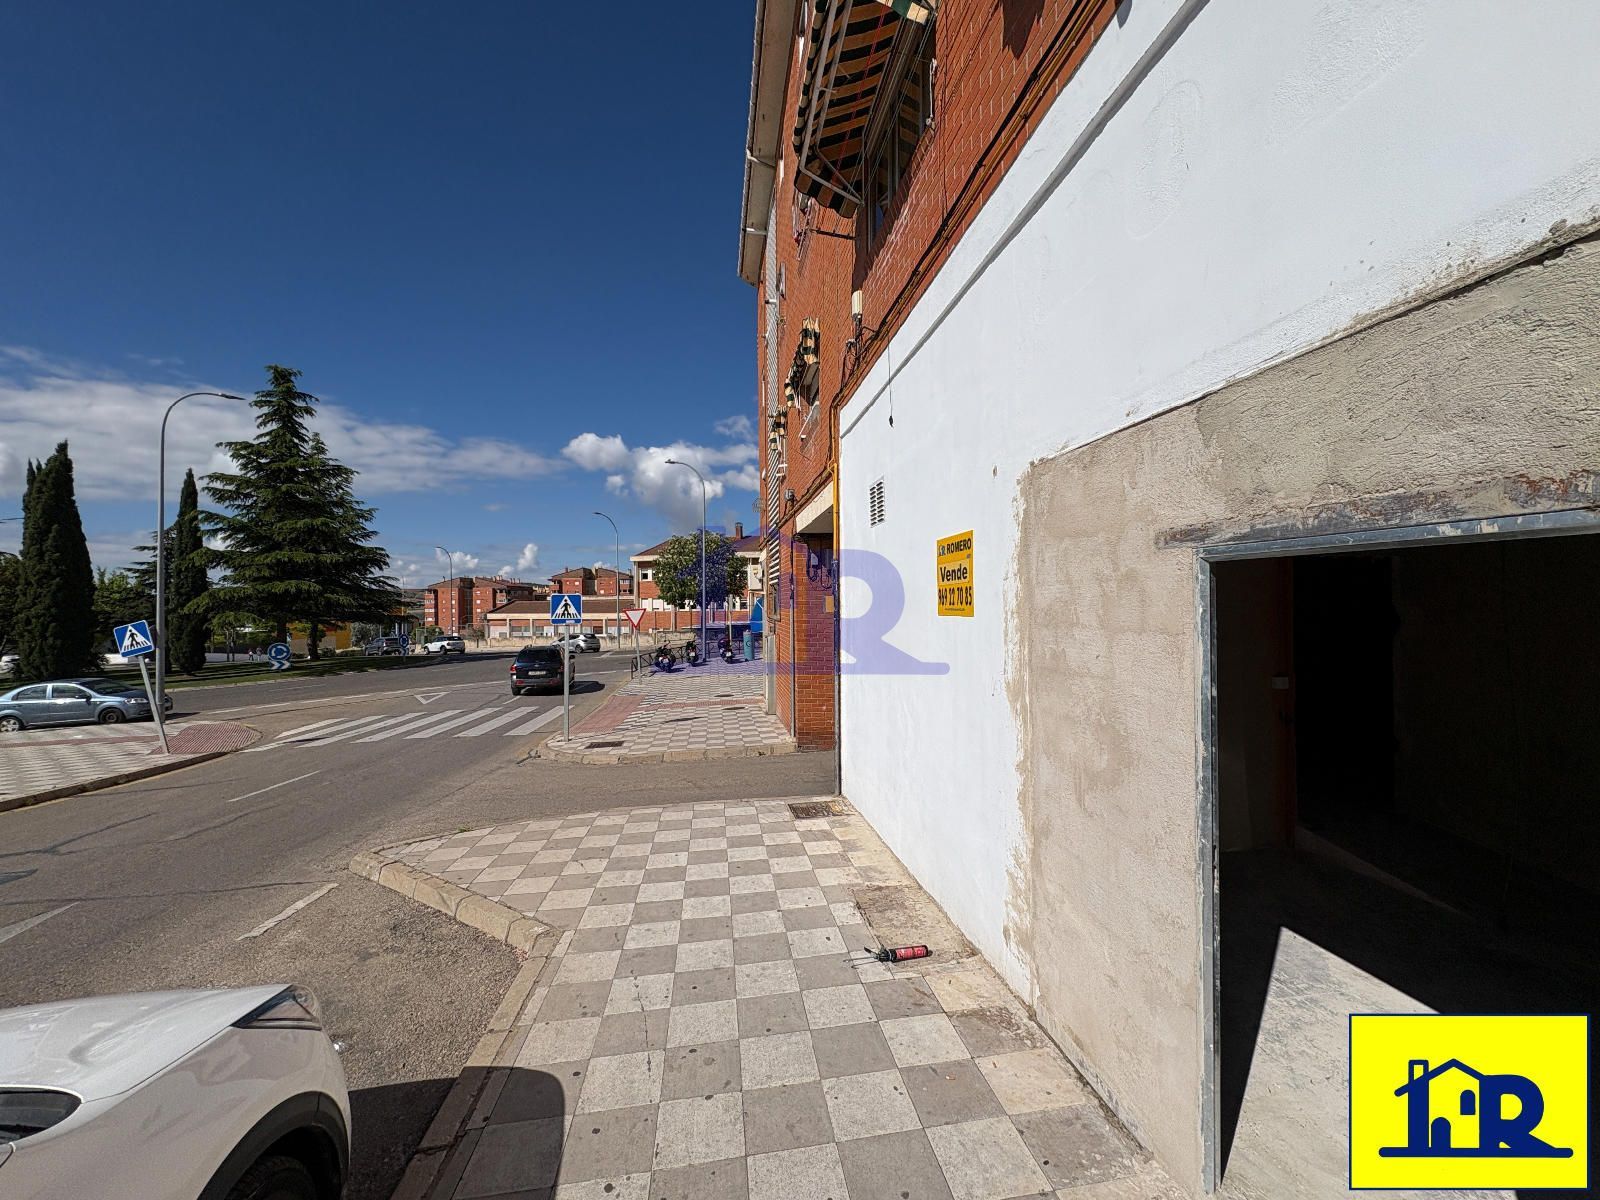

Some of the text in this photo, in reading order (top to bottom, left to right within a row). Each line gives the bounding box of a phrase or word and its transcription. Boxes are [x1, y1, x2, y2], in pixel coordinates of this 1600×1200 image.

[947, 538, 971, 554] ROMERO
[940, 563, 968, 582] Vende
[938, 588, 948, 606] 969
[957, 586, 963, 606] 70
[965, 586, 972, 606] 85
